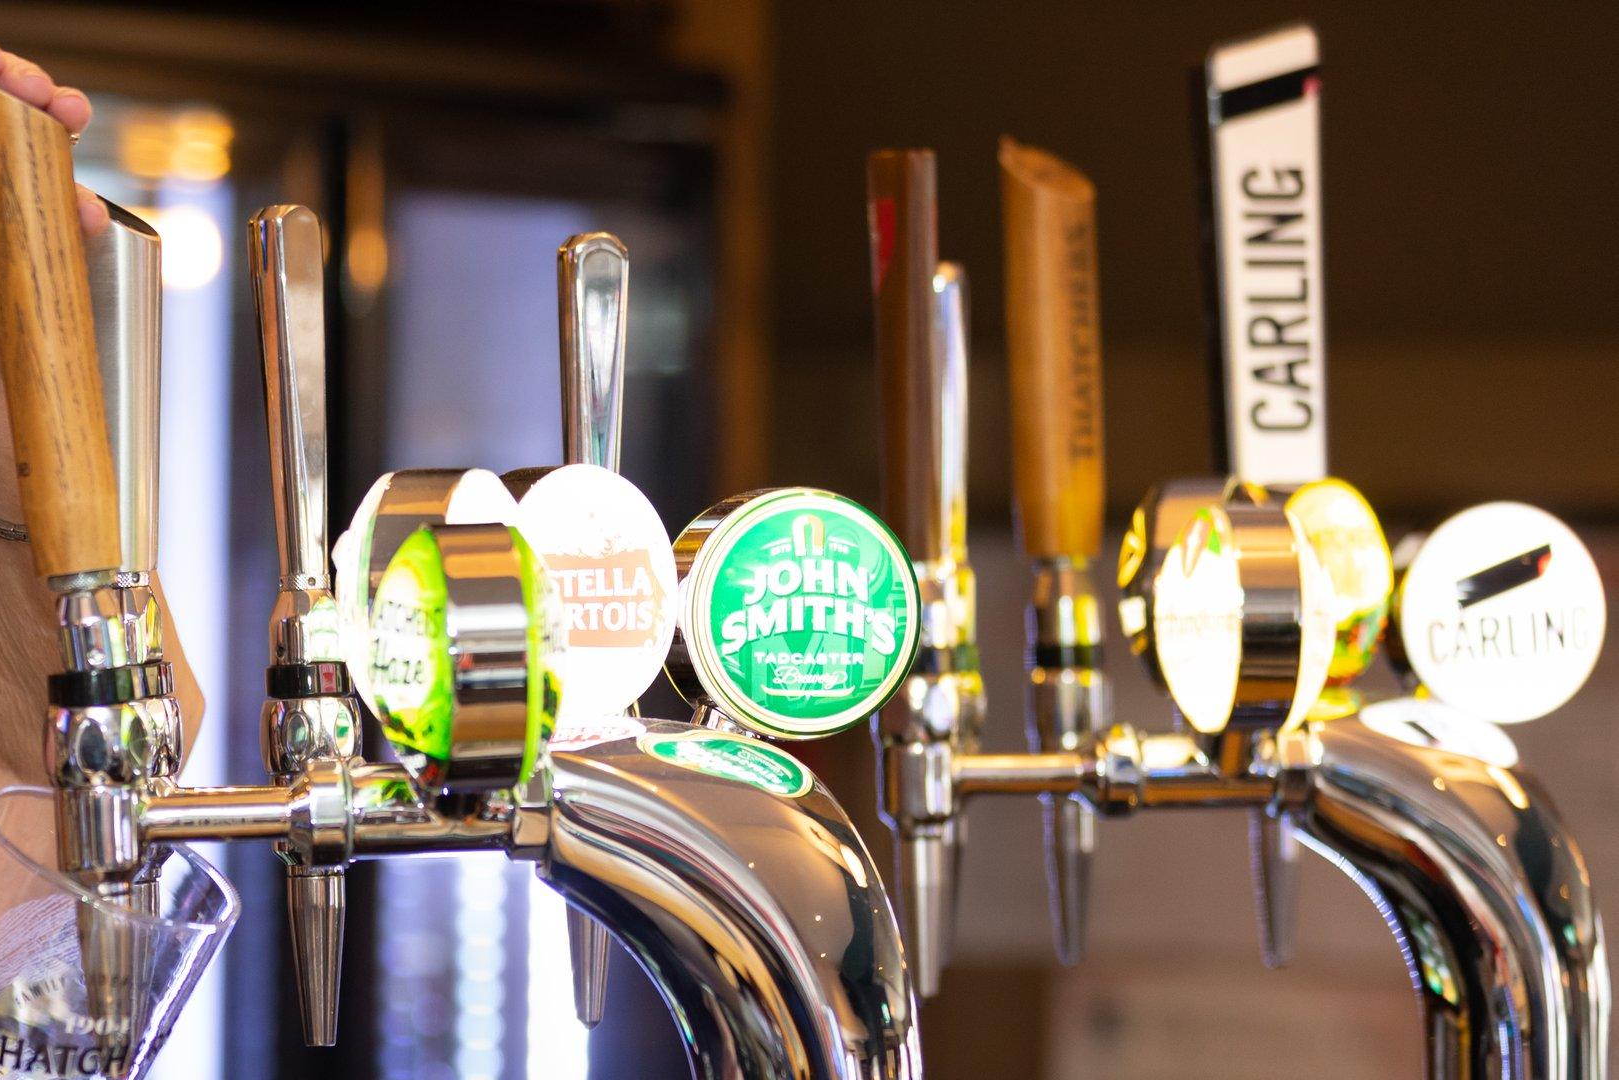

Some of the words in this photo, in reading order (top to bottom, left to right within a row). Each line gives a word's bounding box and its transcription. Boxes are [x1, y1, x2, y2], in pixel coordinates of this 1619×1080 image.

[1241, 166, 1313, 433] CARLING
[744, 558, 870, 606] JOHN
[721, 597, 897, 656] SMITH'S
[1427, 607, 1589, 665] CARLING
[754, 652, 864, 666] TADCASTER
